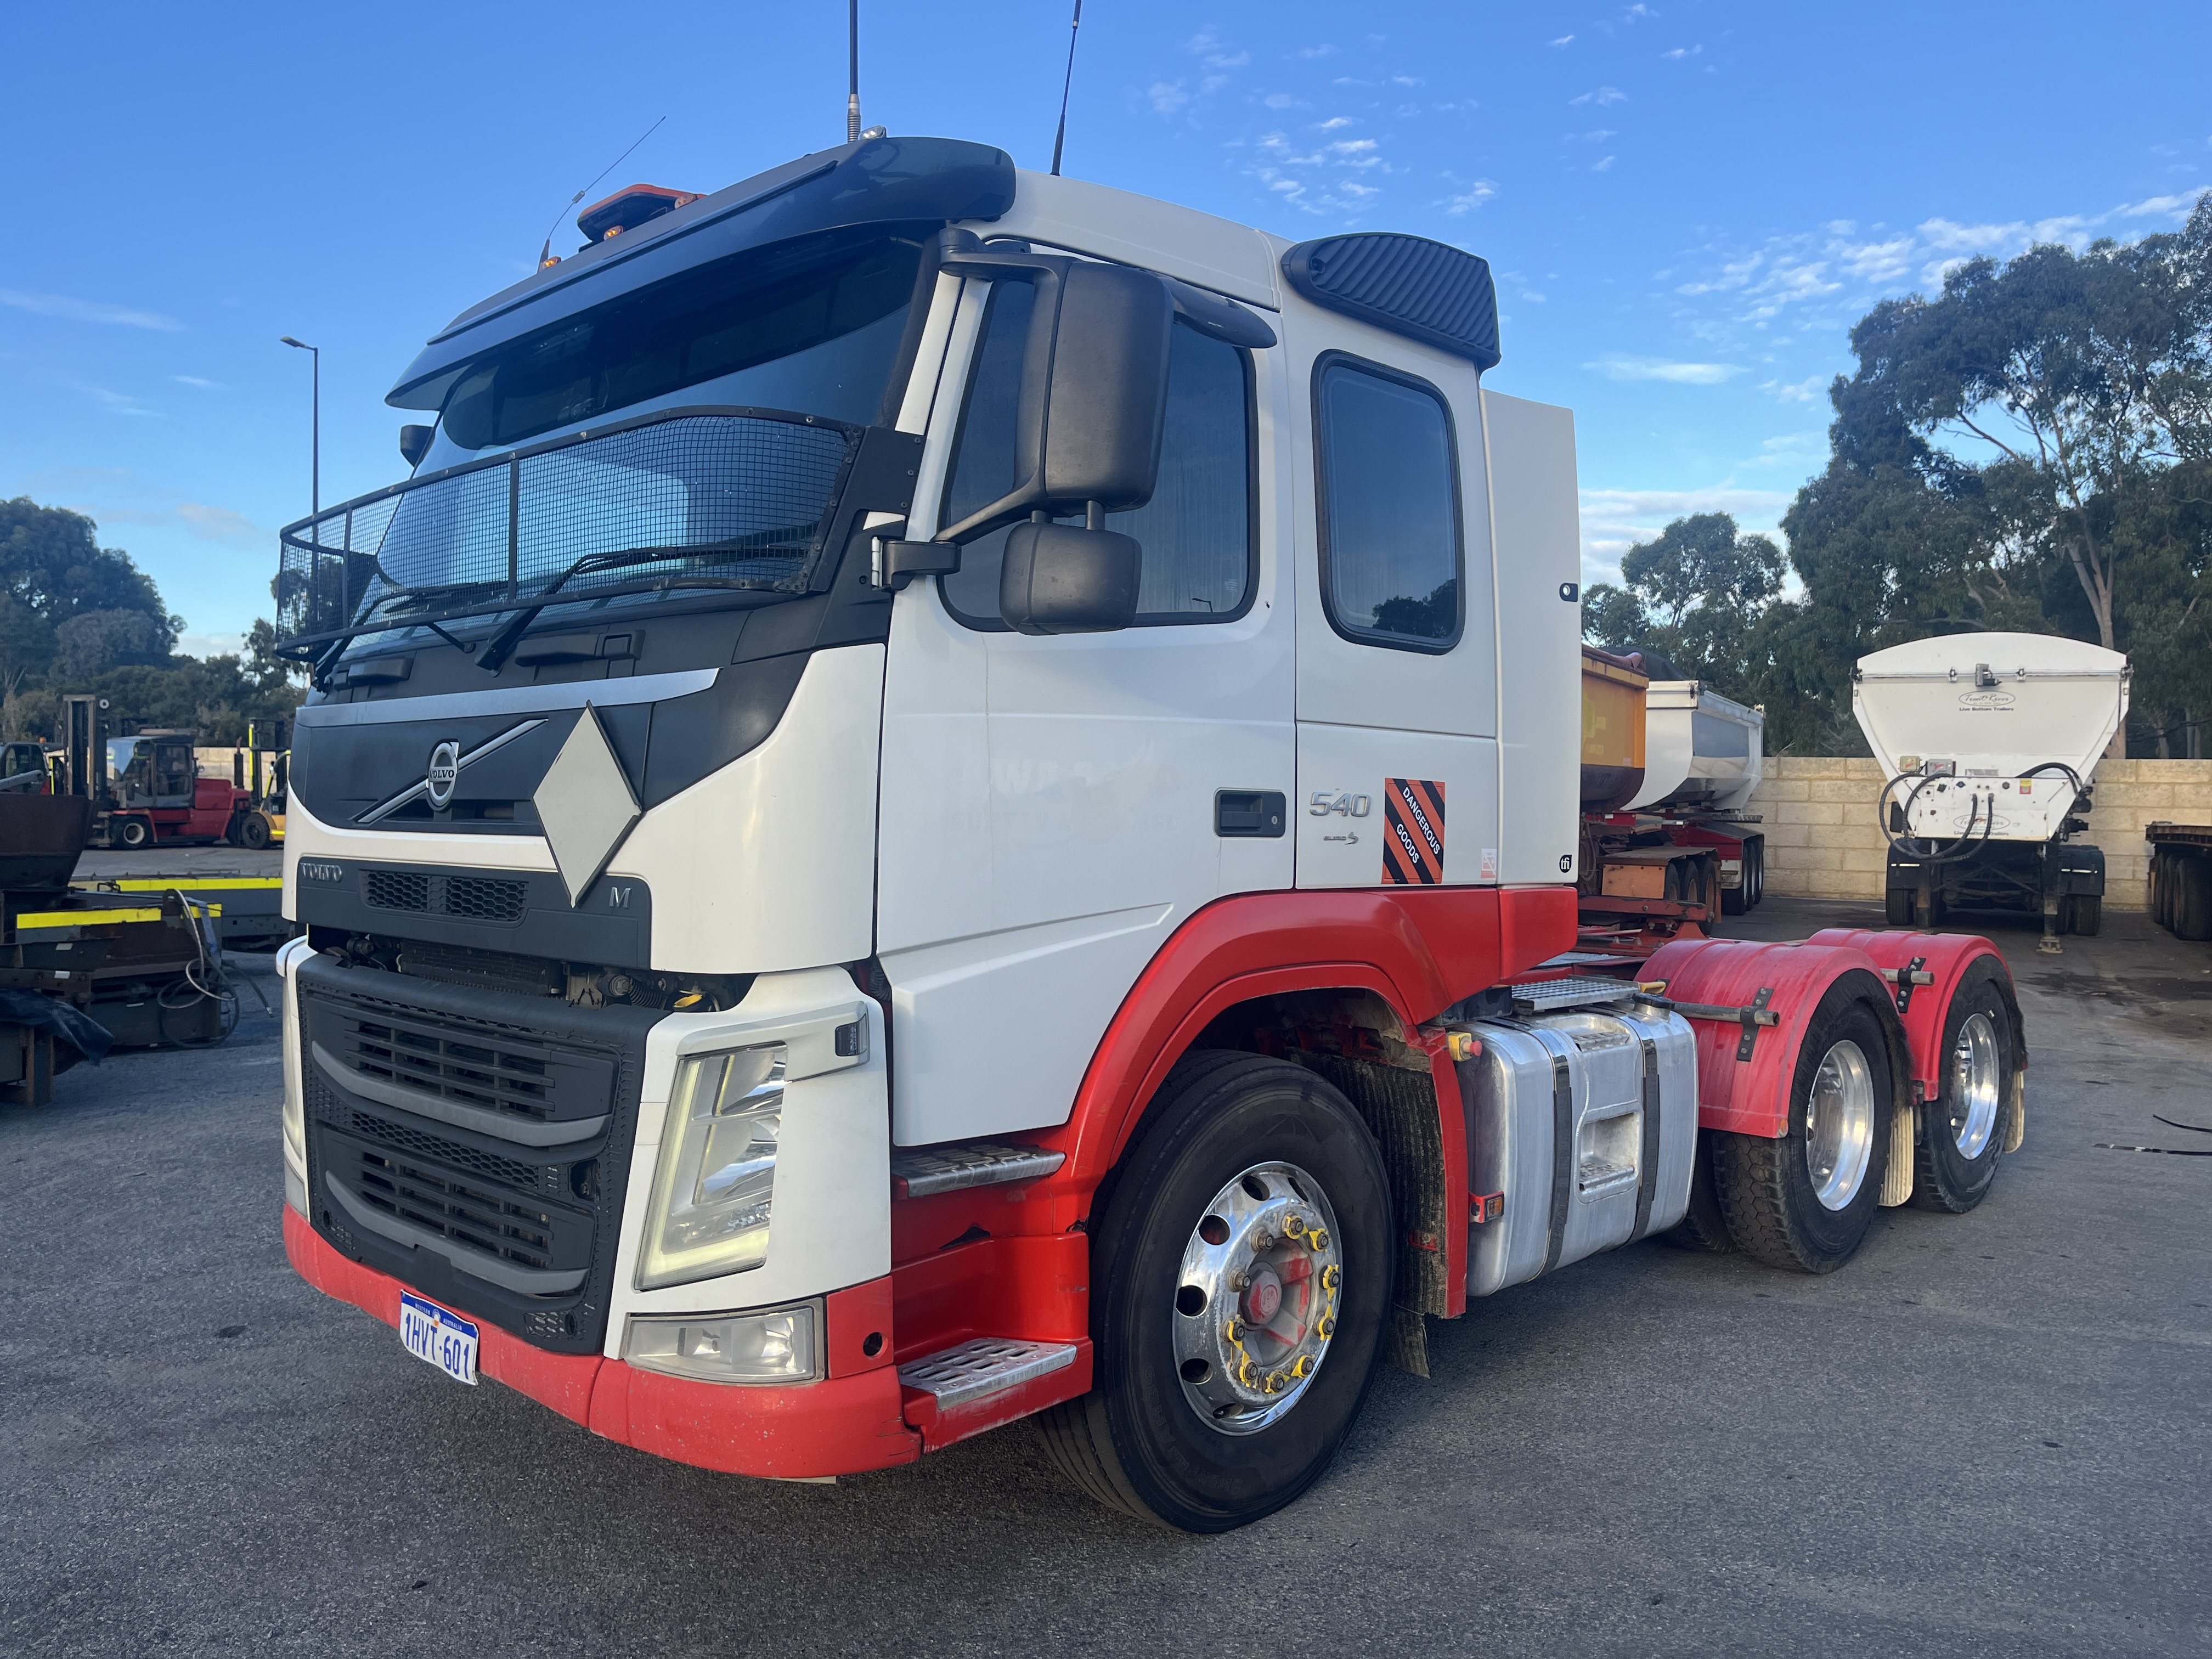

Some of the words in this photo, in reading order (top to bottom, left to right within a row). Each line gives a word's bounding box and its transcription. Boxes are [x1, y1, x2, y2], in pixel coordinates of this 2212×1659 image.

[430, 770, 455, 778] VOLVO
[1310, 792, 1372, 817] 540
[1403, 787, 1440, 855] DANGEROUS
[1397, 823, 1419, 864] GOODS
[299, 862, 343, 882] VOLVO
[1560, 856, 1570, 870] tfi
[608, 887, 631, 908] M
[415, 1303, 431, 1316] WESTERN
[443, 1318, 462, 1331] AUSTRALIA
